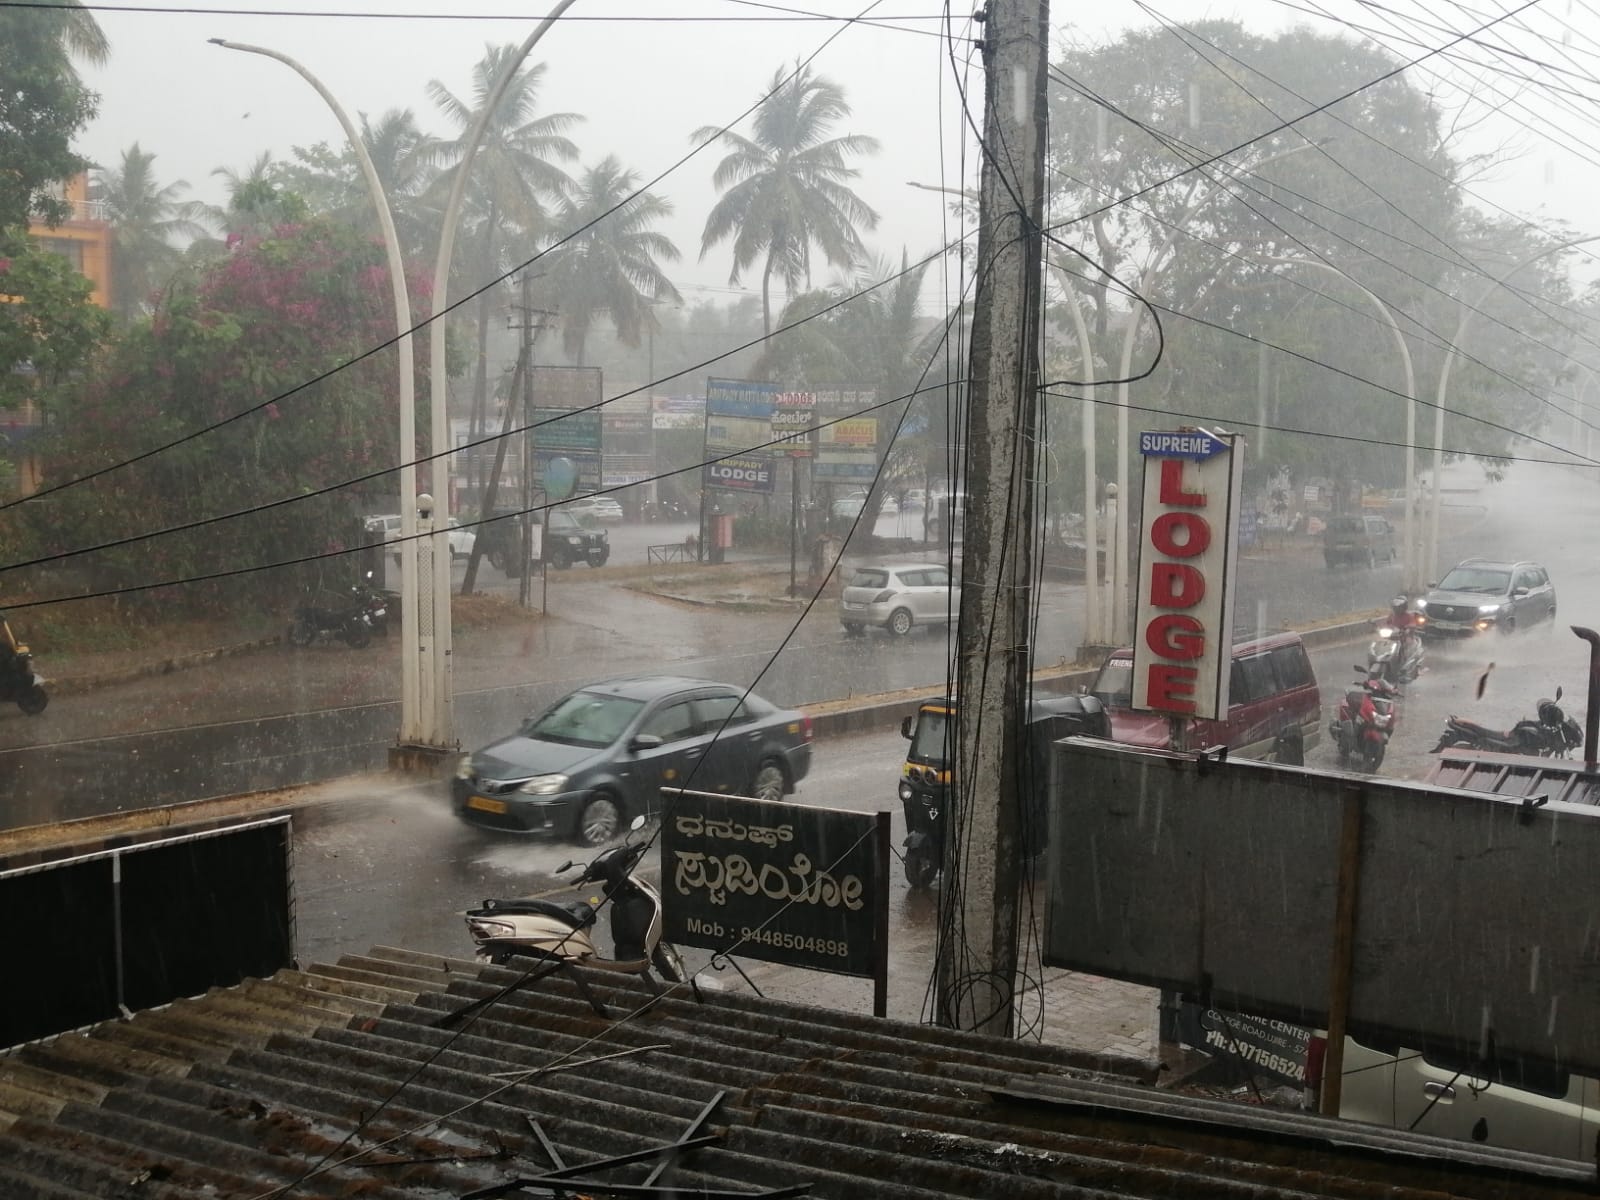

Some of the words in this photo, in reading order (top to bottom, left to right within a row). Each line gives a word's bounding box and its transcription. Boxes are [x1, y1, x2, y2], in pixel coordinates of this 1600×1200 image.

[771, 430, 812, 444] HOTEL
[1142, 435, 1211, 455] SUPREME
[711, 465, 769, 483] LODGE
[1146, 459, 1211, 712] LODGE
[676, 814, 793, 849] ಧನುಷ್
[674, 850, 864, 911] ಸ್ಟುಡಿಯೋ
[687, 917, 725, 938] Mob
[740, 926, 849, 958] 9448504898
[1207, 1009, 1242, 1031] COLEGE
[1270, 1020, 1311, 1043] CENTER
